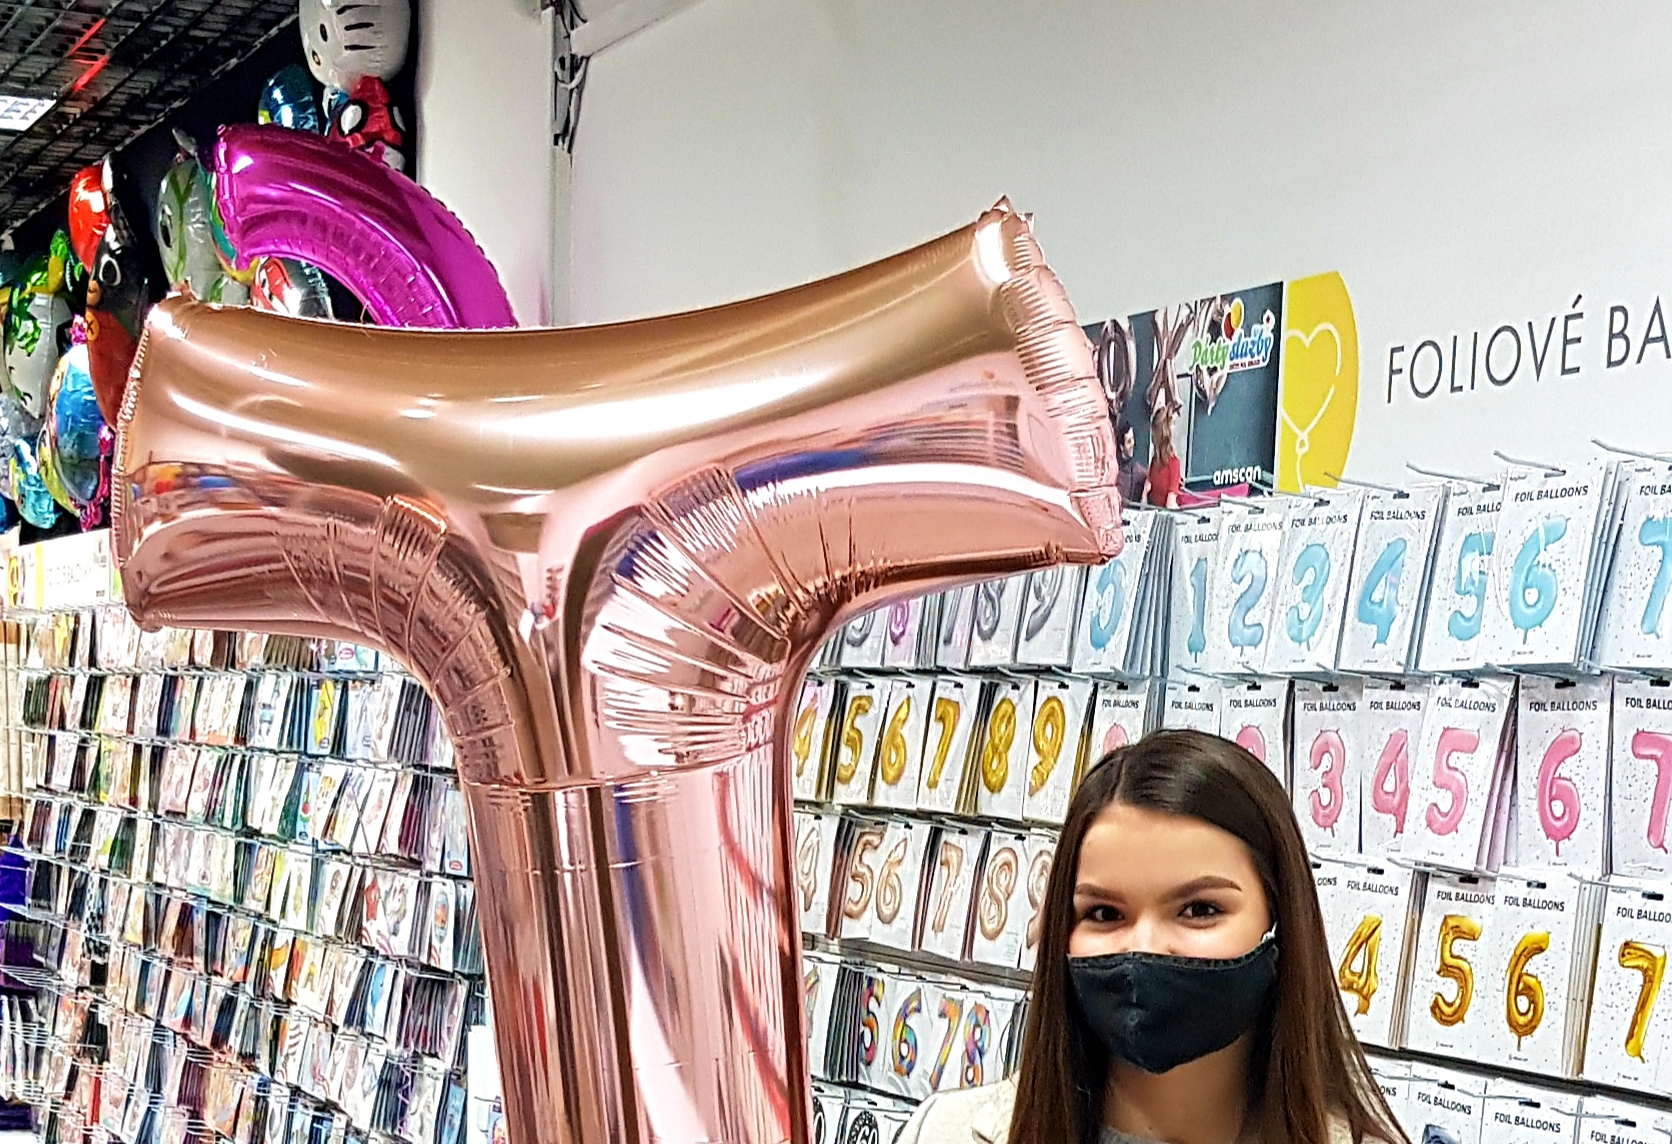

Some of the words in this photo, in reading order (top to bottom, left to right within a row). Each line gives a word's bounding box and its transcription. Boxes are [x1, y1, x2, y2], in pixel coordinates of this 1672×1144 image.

[1386, 293, 1584, 404] FOLIOVÉ
[1606, 295, 1672, 369] BA
[1213, 465, 1262, 485] amscan
[1514, 492, 1534, 503] FOIL
[1536, 485, 1589, 501] BALLOONS
[1639, 485, 1657, 496] FOIL
[1508, 514, 1569, 634] 6
[1227, 549, 1268, 650] 2
[1286, 543, 1330, 646] 3
[1357, 537, 1407, 647] 4
[1303, 703, 1317, 712] FOIL
[1319, 702, 1357, 712] BALLOONS
[1370, 701, 1384, 710] FOIL
[1386, 701, 1421, 711] BALLOONS
[1454, 699, 1497, 713] BALLOONS
[1529, 701, 1548, 712] FOIL
[1550, 700, 1598, 712] BALLOONS
[1625, 697, 1643, 709] FOIL
[1309, 727, 1347, 832] 3
[1425, 726, 1481, 836] 5
[1537, 727, 1584, 844] 6
[1347, 880, 1361, 891] FOIL
[1362, 881, 1399, 896] BALLOONS
[1437, 890, 1452, 901] FOIL
[1454, 893, 1496, 905] BALLOONS
[1504, 895, 1521, 907] FOIL
[1522, 898, 1565, 912] BALLOONS
[1616, 906, 1634, 919] FOIL
[1338, 913, 1383, 1016] 4
[1430, 914, 1483, 1027] 5
[1506, 931, 1551, 1040] 6
[1618, 939, 1667, 1064] 7
[1433, 1095, 1472, 1115] BALLOONS
[1494, 1112, 1513, 1126] FOIL
[1514, 1115, 1562, 1134] BALLOONS
[1590, 1130, 1608, 1144] FOIL
